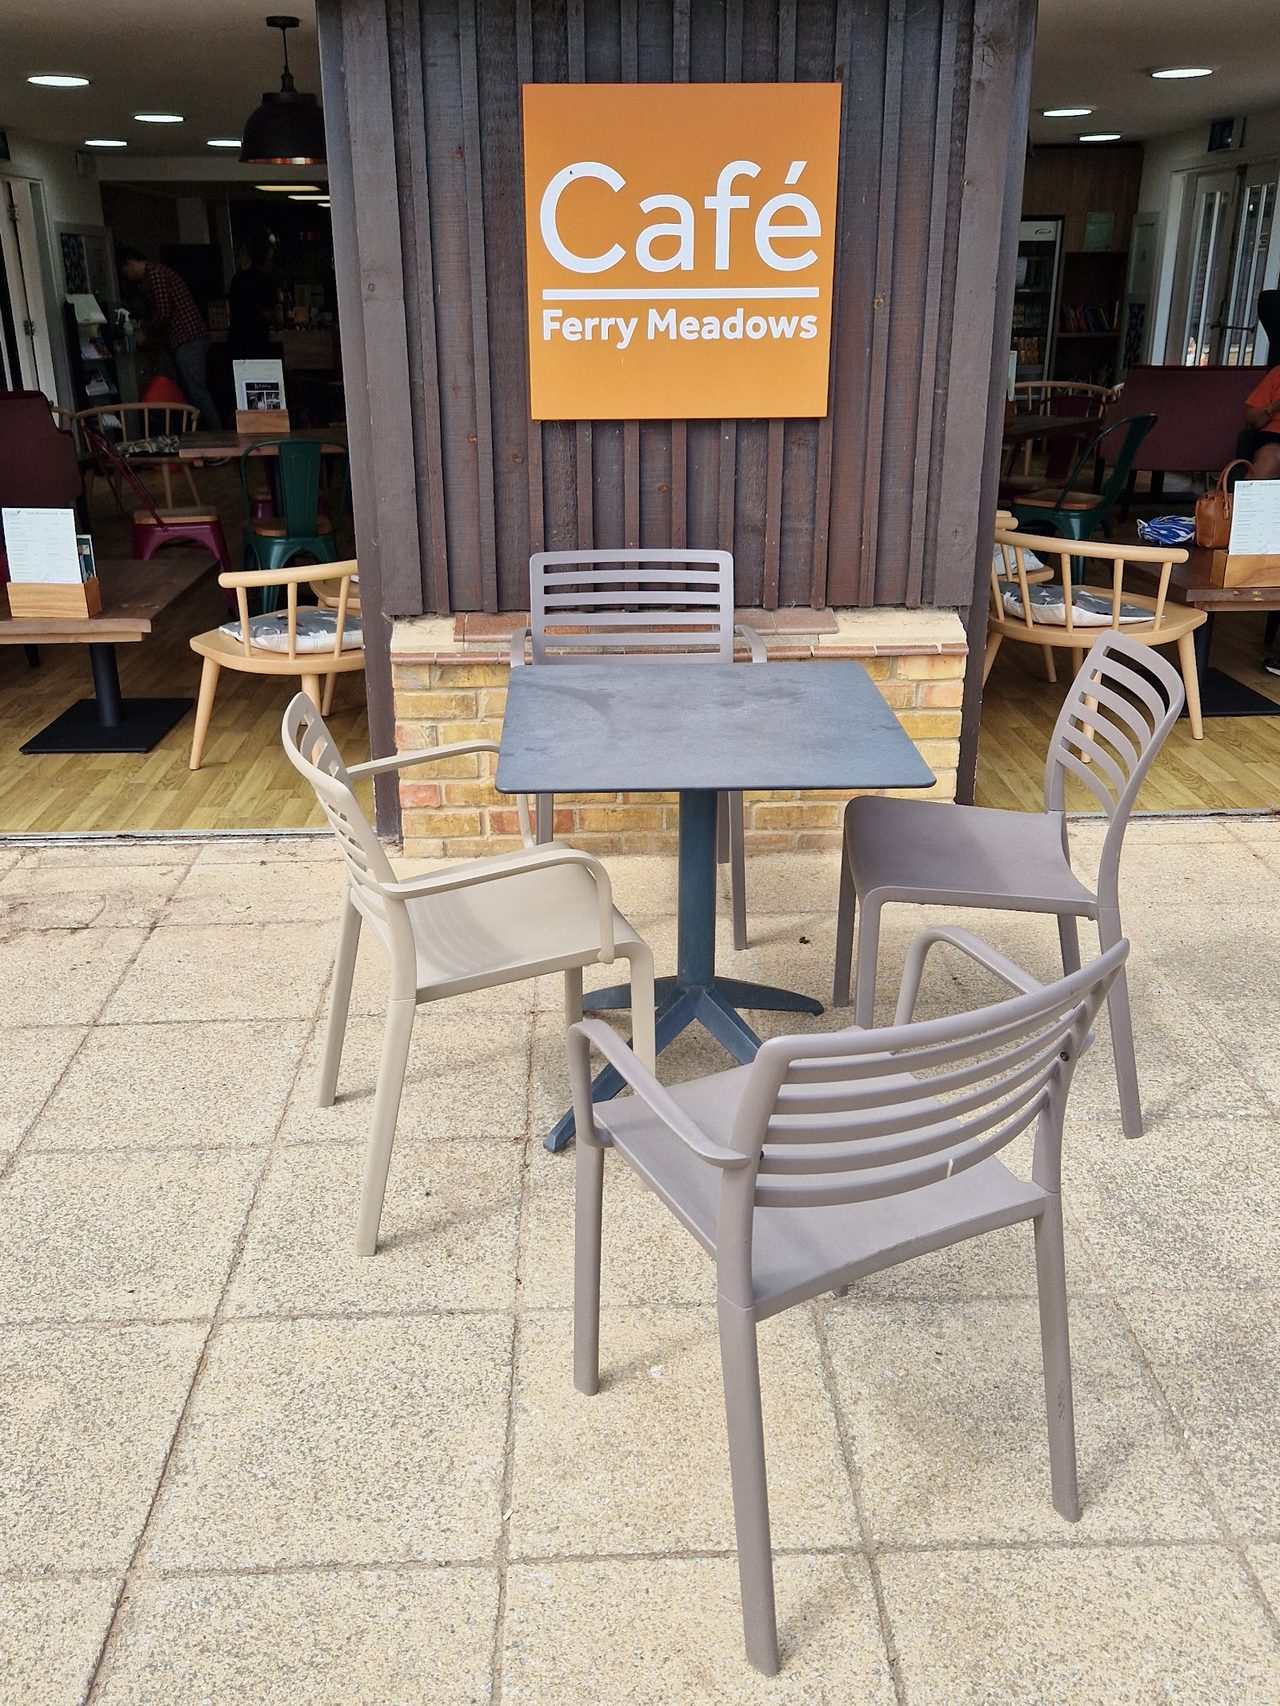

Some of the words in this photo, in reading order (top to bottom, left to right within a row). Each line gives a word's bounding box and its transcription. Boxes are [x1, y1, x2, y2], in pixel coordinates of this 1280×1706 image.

[539, 159, 823, 274] Café
[542, 308, 639, 350] Ferry
[647, 308, 818, 341] Meadows
